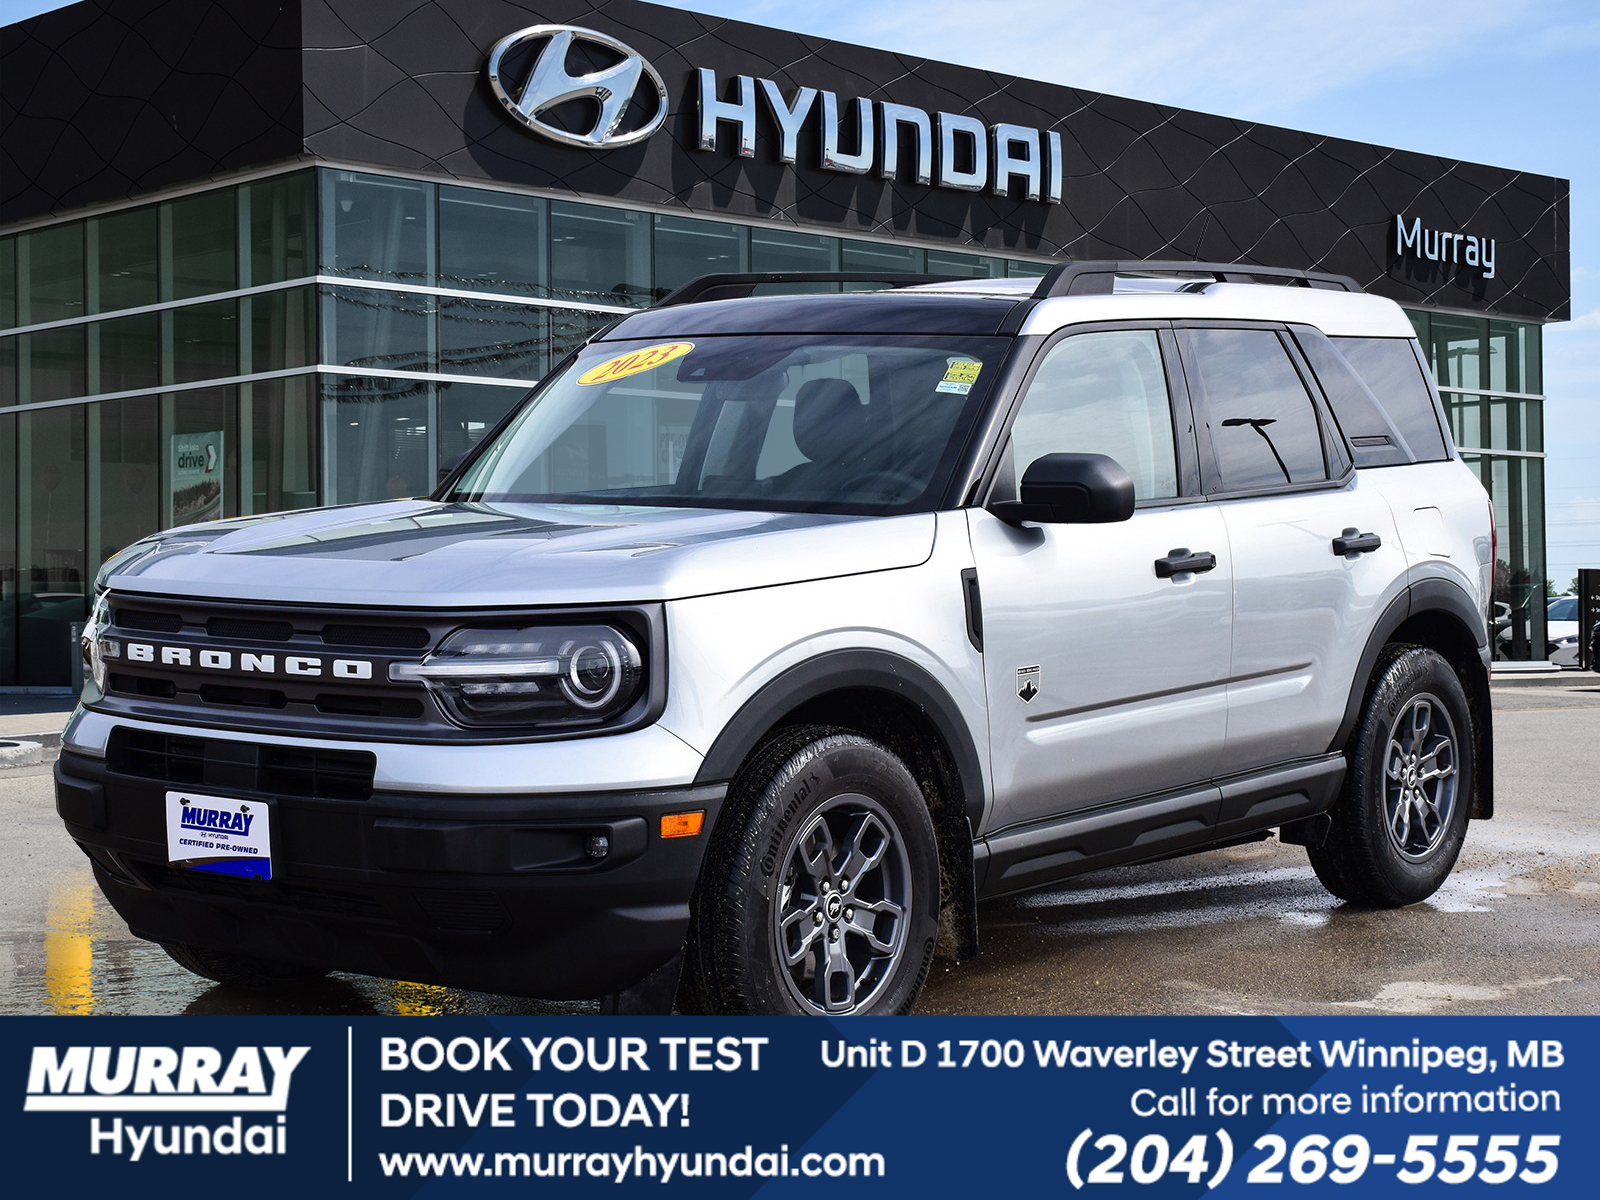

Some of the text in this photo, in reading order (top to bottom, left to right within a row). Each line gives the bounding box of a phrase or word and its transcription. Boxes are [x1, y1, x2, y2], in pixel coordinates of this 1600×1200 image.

[697, 67, 1062, 205] HYUNDAI
[1396, 213, 1496, 279] Murray
[591, 345, 679, 381] 2023
[178, 452, 204, 469] drive
[127, 643, 372, 679] BRONCO
[181, 806, 254, 834] MURRAY
[760, 779, 812, 877] Continental
[179, 838, 258, 854] CERTIFIED PRE-OWNED
